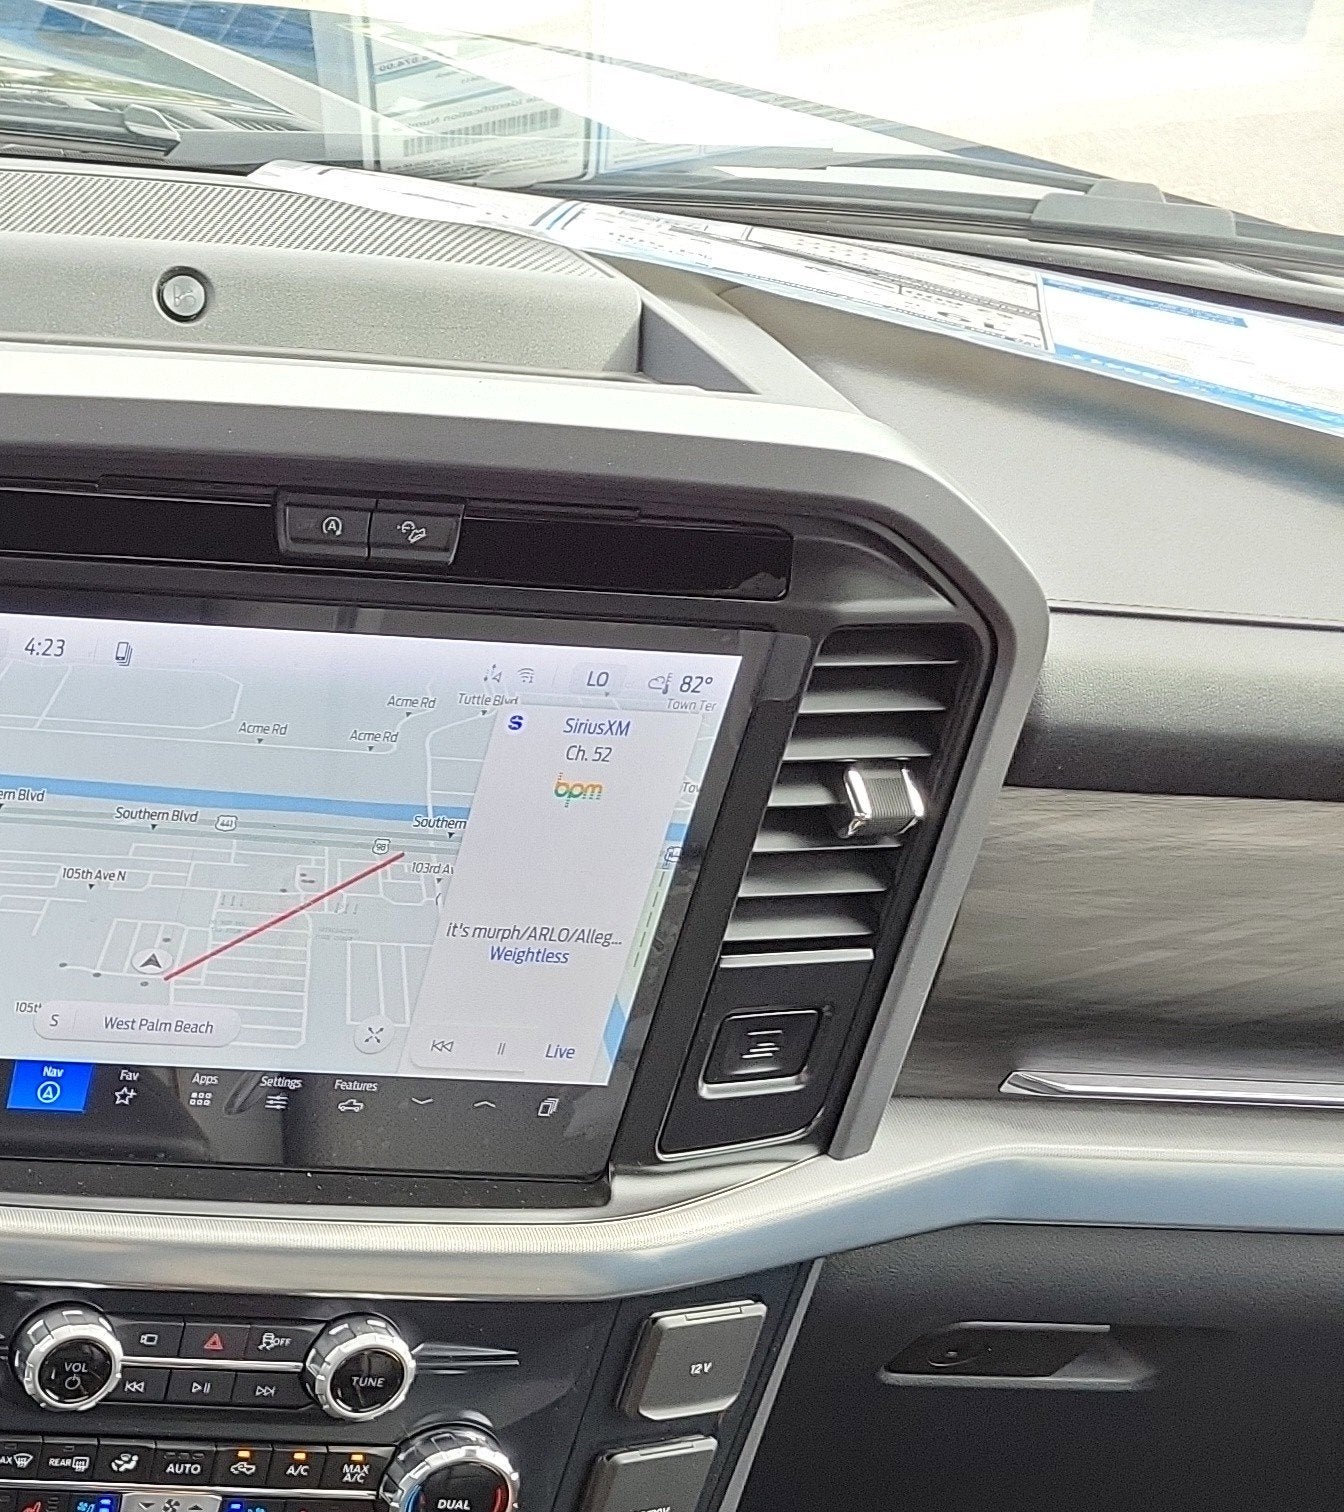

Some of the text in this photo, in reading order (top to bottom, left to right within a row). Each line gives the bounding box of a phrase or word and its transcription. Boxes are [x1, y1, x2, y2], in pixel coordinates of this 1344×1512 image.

[24, 637, 65, 658] 4:23
[587, 671, 609, 687] LO
[387, 695, 436, 709] Acme Rd
[458, 692, 491, 706] Tuttle
[666, 698, 697, 711] Town
[238, 722, 287, 735] Acme Rd
[563, 717, 631, 737] SiriusXM
[349, 729, 399, 743] Acme Rd
[566, 744, 612, 762] Ch. 52
[18, 788, 45, 803] Blvd
[554, 772, 603, 808] bpm
[115, 807, 198, 824] Southern Blvd
[413, 816, 466, 829] Southern
[62, 867, 127, 882] 105th Ave N
[412, 862, 442, 874] 103rd
[446, 922, 470, 938] it's
[490, 946, 569, 965] Weightless
[49, 1014, 59, 1027] S
[104, 1015, 213, 1035] West Palm Beach
[546, 1043, 575, 1059] Live
[43, 1065, 64, 1078] Nav
[119, 1069, 140, 1082] Fav
[192, 1072, 218, 1087] Apps
[260, 1075, 302, 1091] Settings
[334, 1079, 378, 1092] Features
[273, 1336, 291, 1347] OFF
[64, 1361, 88, 1373] VOL
[351, 1376, 386, 1388] TUNE
[49, 1457, 72, 1467] REAR
[166, 1463, 201, 1475] AUTO
[286, 1464, 309, 1476] A/C
[343, 1464, 369, 1474] MAX
[342, 1472, 364, 1483] A/C
[438, 1499, 470, 1511] DUAL
